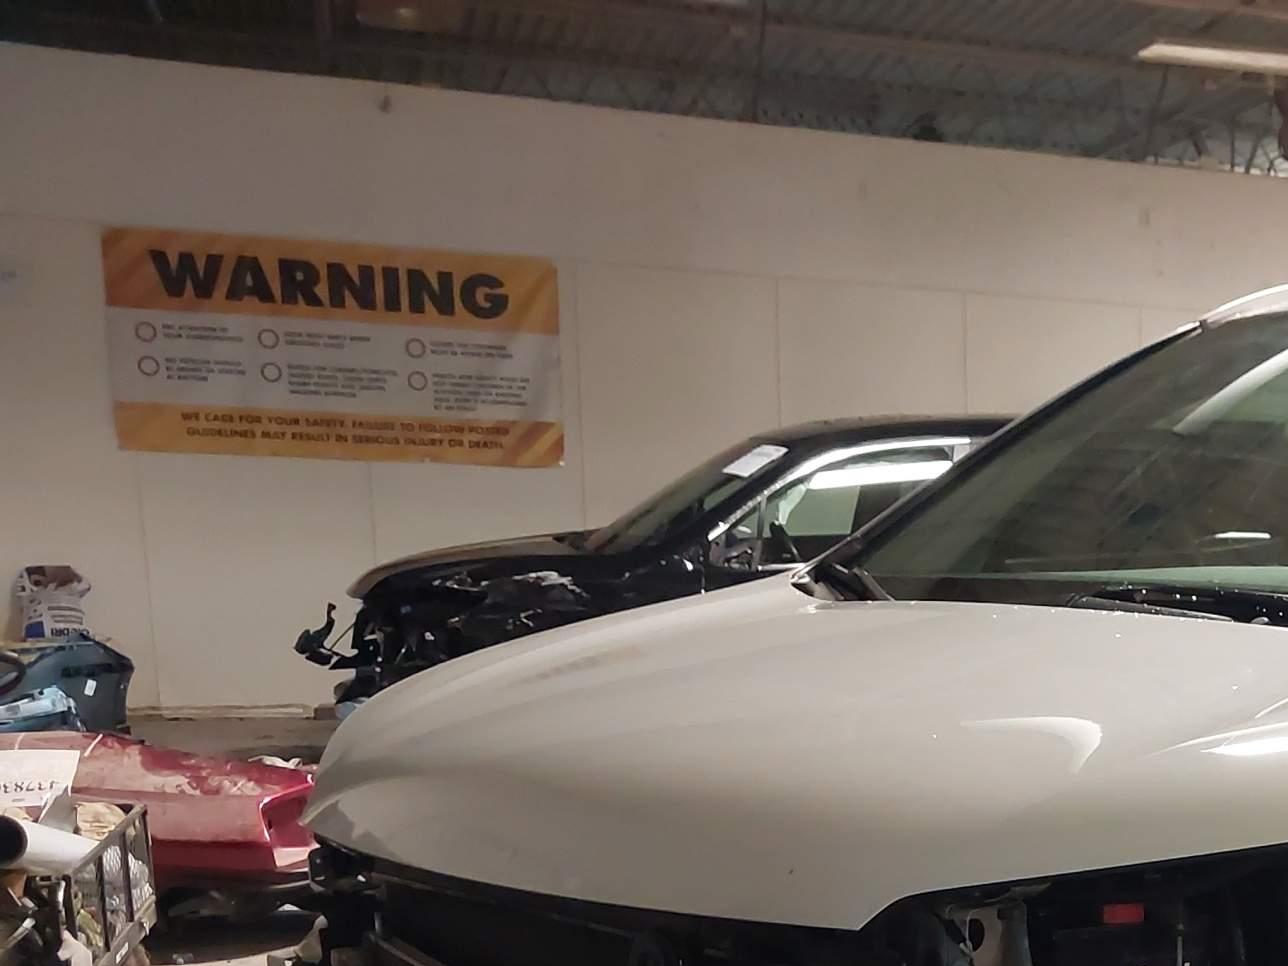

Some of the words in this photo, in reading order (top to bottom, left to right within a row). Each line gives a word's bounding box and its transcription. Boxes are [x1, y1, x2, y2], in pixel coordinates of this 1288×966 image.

[147, 249, 509, 319] WARNING
[181, 412, 200, 422] WE
[205, 413, 235, 424] CARE
[239, 414, 262, 425] FOR
[268, 415, 300, 427] YOUR
[352, 419, 395, 431] FAILURE
[400, 422, 415, 432] TO
[418, 422, 465, 434] FOLLOW
[468, 425, 510, 436] POSTED
[186, 426, 256, 440] GUIDELINES
[261, 430, 286, 441] MAY
[291, 431, 330, 443] RESULT
[335, 434, 348, 444] IN
[352, 434, 400, 446] SERIOUS
[404, 437, 443, 447] INJURY
[448, 438, 464, 448] OR
